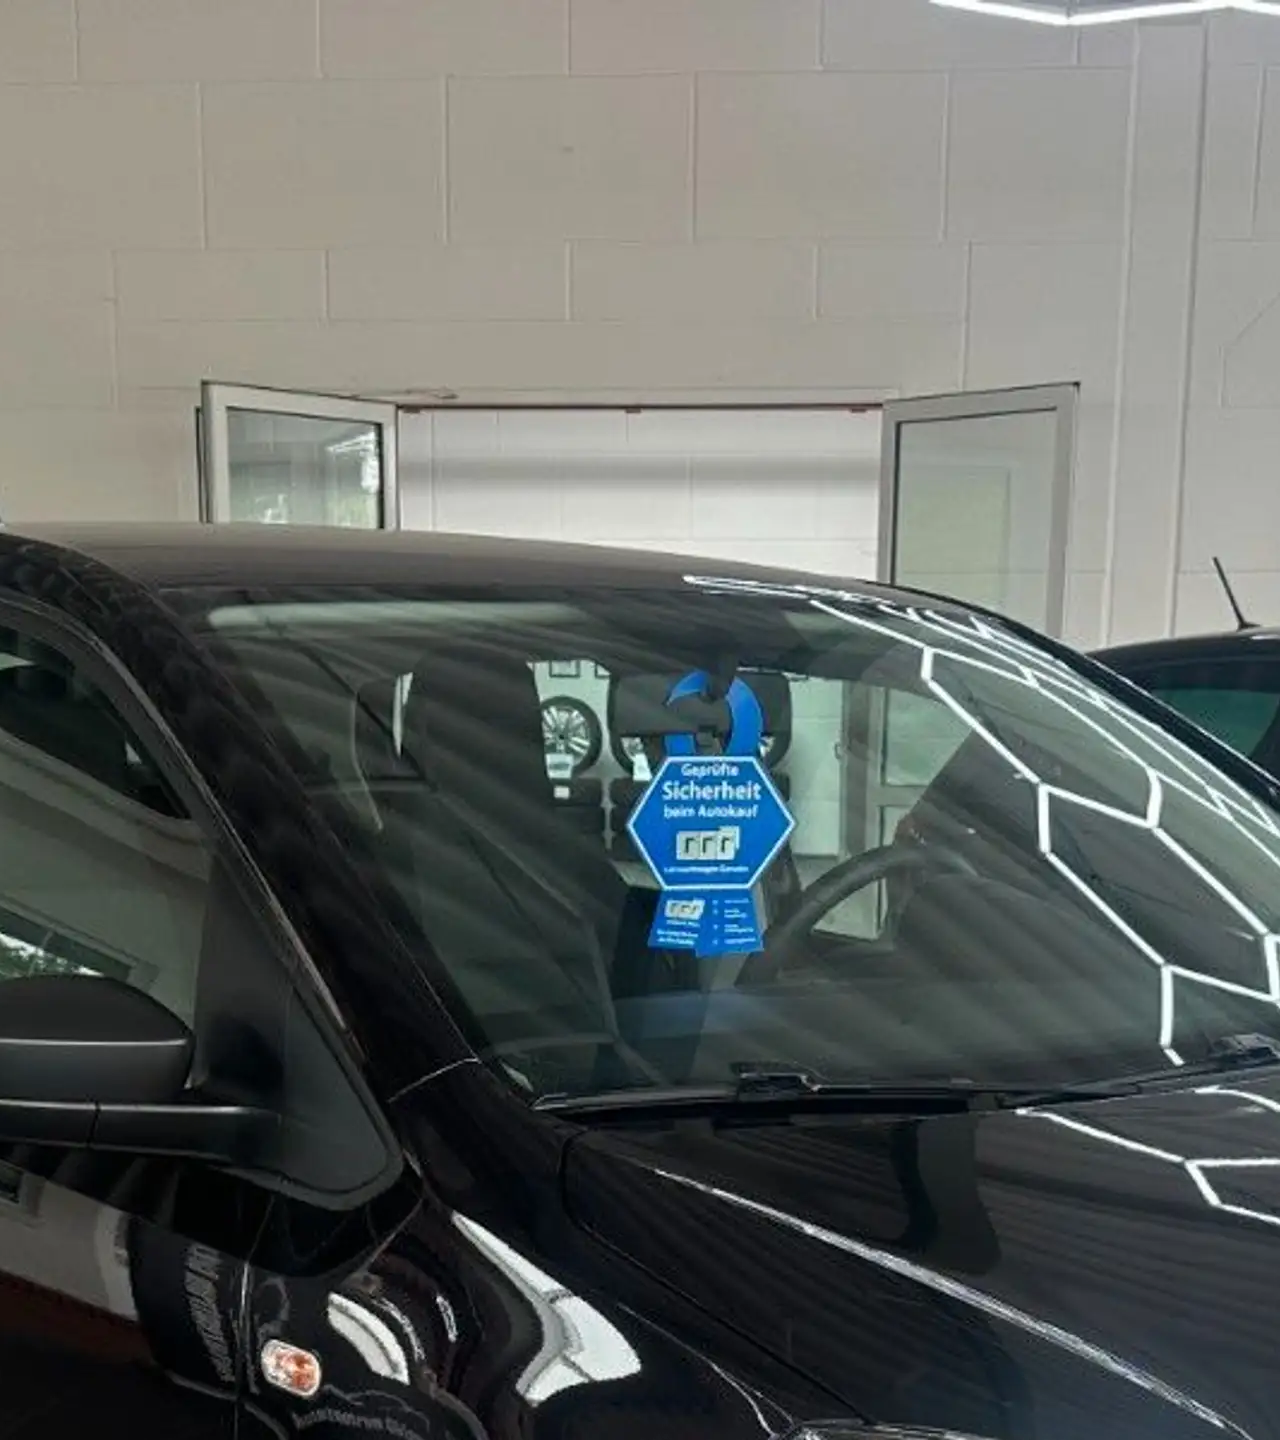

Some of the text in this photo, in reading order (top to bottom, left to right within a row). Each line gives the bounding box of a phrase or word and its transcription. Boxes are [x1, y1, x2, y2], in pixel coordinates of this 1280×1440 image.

[681, 763, 740, 779] Geprüfte
[662, 780, 762, 801] Sicherheit
[663, 804, 759, 819] beim Autokauf
